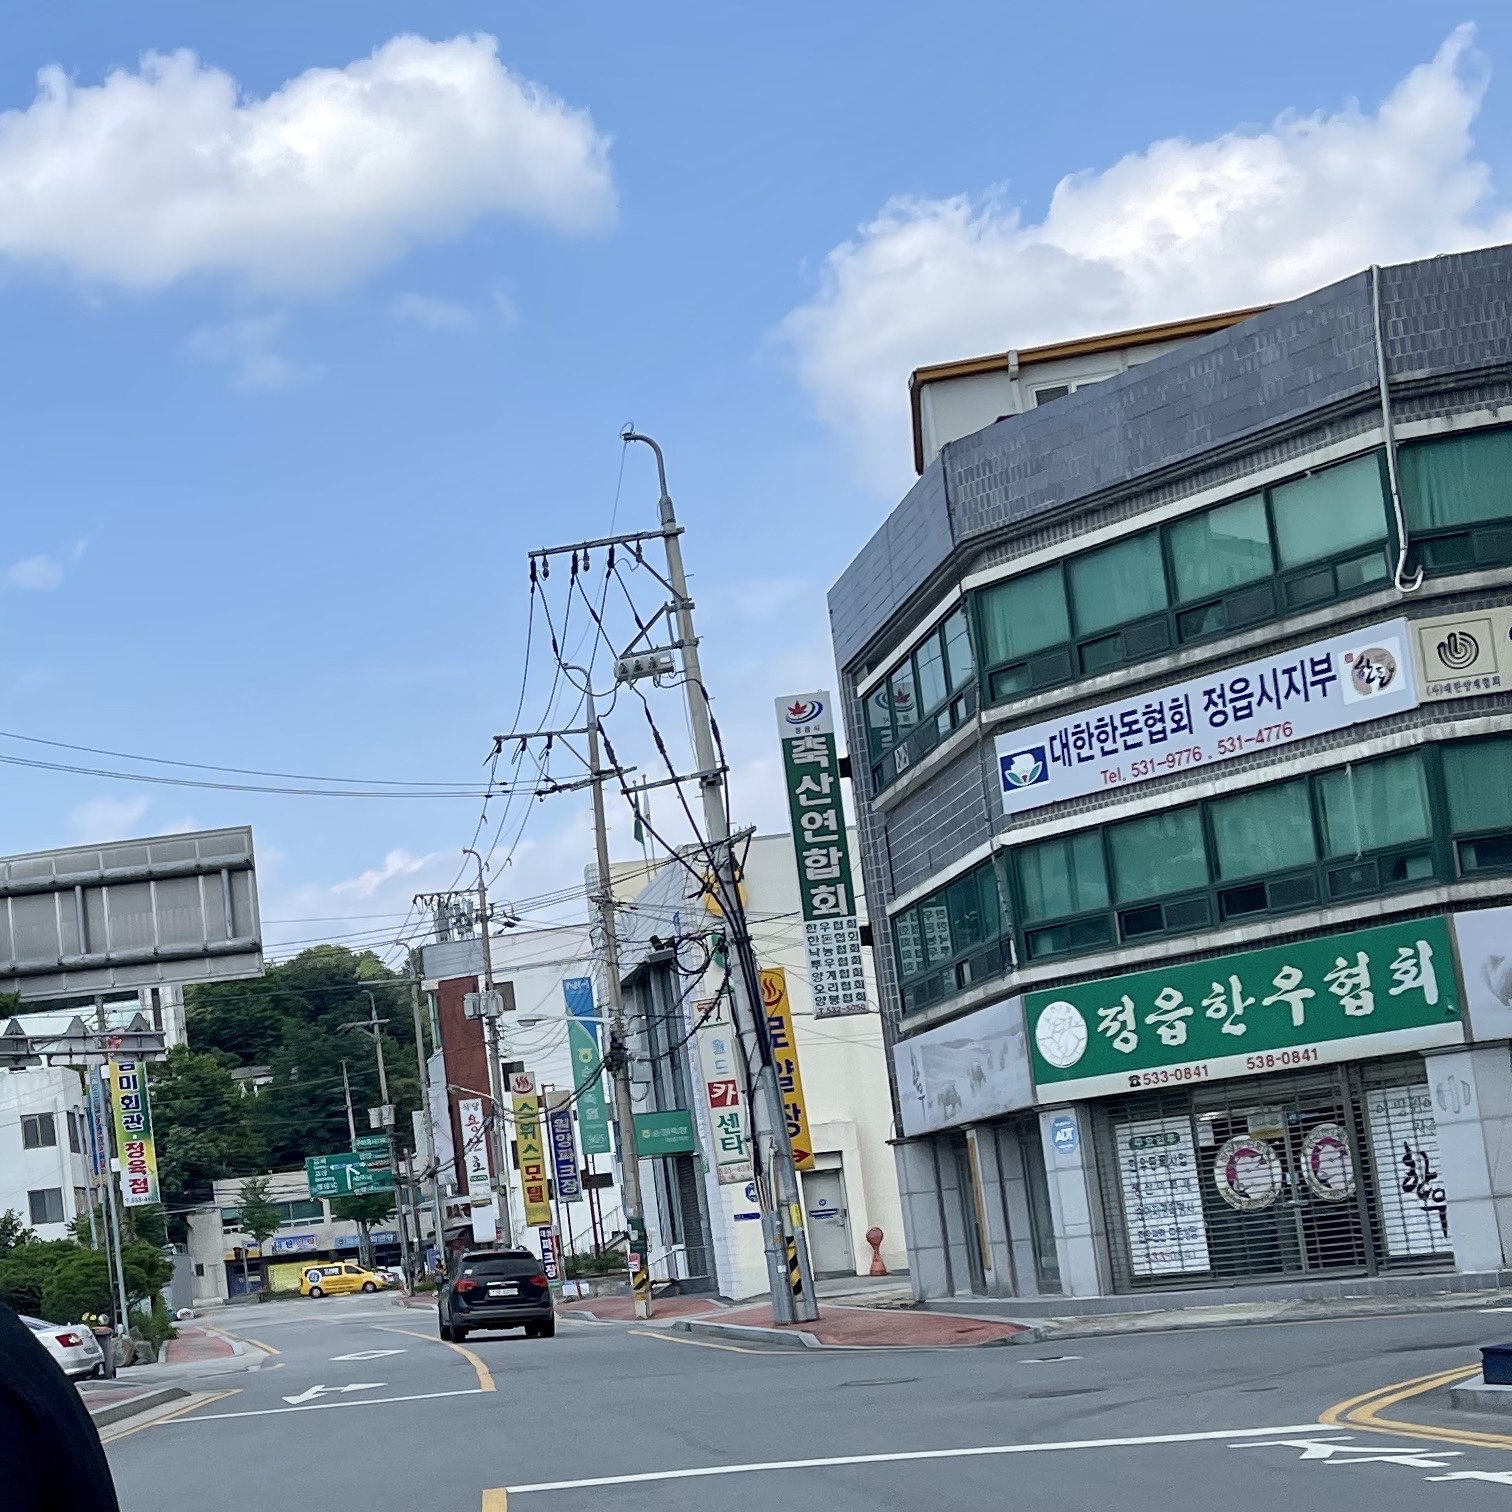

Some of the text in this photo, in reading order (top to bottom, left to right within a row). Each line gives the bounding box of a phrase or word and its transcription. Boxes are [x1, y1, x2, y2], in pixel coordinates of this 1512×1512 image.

[1049, 652, 1338, 768] 대한한돈협회 정읍시지부
[1100, 721, 1294, 786] Tel. 531-9776 531-4776
[791, 736, 849, 916] 축산연합회
[806, 919, 857, 933] 한우협회
[809, 943, 860, 957] 낙농협회
[812, 967, 863, 982] 양계협회
[814, 980, 865, 994] 오리협회
[1097, 940, 1439, 1053] 정읍한우협회
[1143, 1048, 1319, 1086] 533-0841 538-0841
[710, 1082, 743, 1155] 카센타
[1055, 1127, 1074, 1143] ADT
[124, 1141, 150, 1194] 정육점
